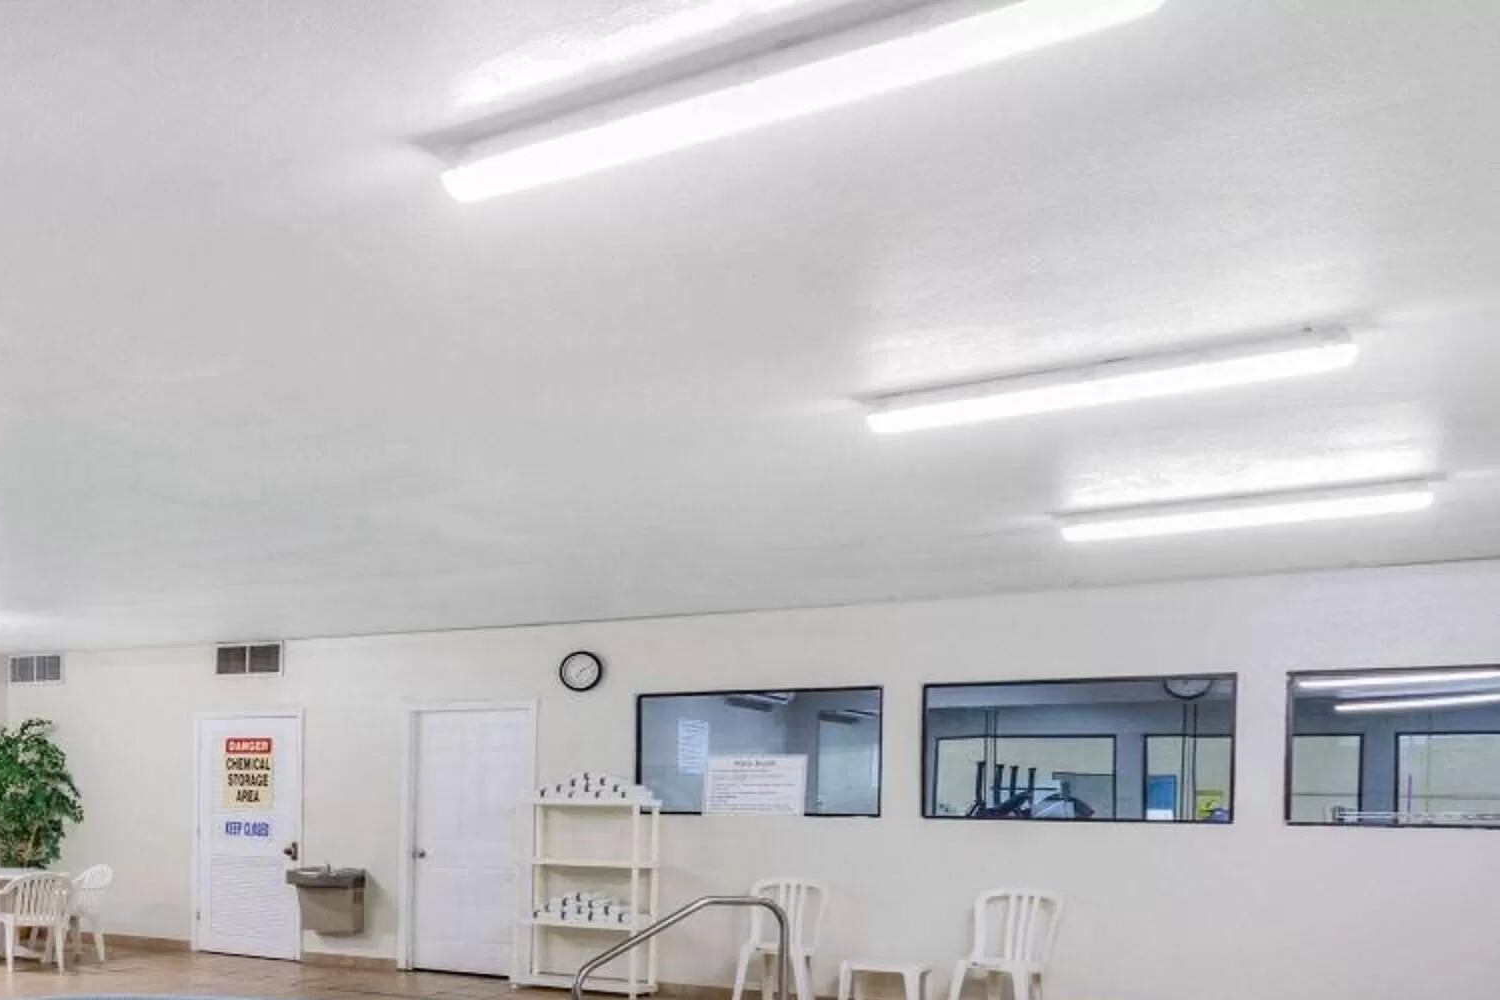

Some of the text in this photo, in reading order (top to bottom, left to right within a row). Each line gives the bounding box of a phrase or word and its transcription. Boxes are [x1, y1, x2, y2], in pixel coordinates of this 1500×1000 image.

[228, 740, 269, 752] DANGER
[226, 757, 270, 770] CHEMICAL
[227, 773, 269, 787] STORAGE
[236, 789, 260, 802] AREA
